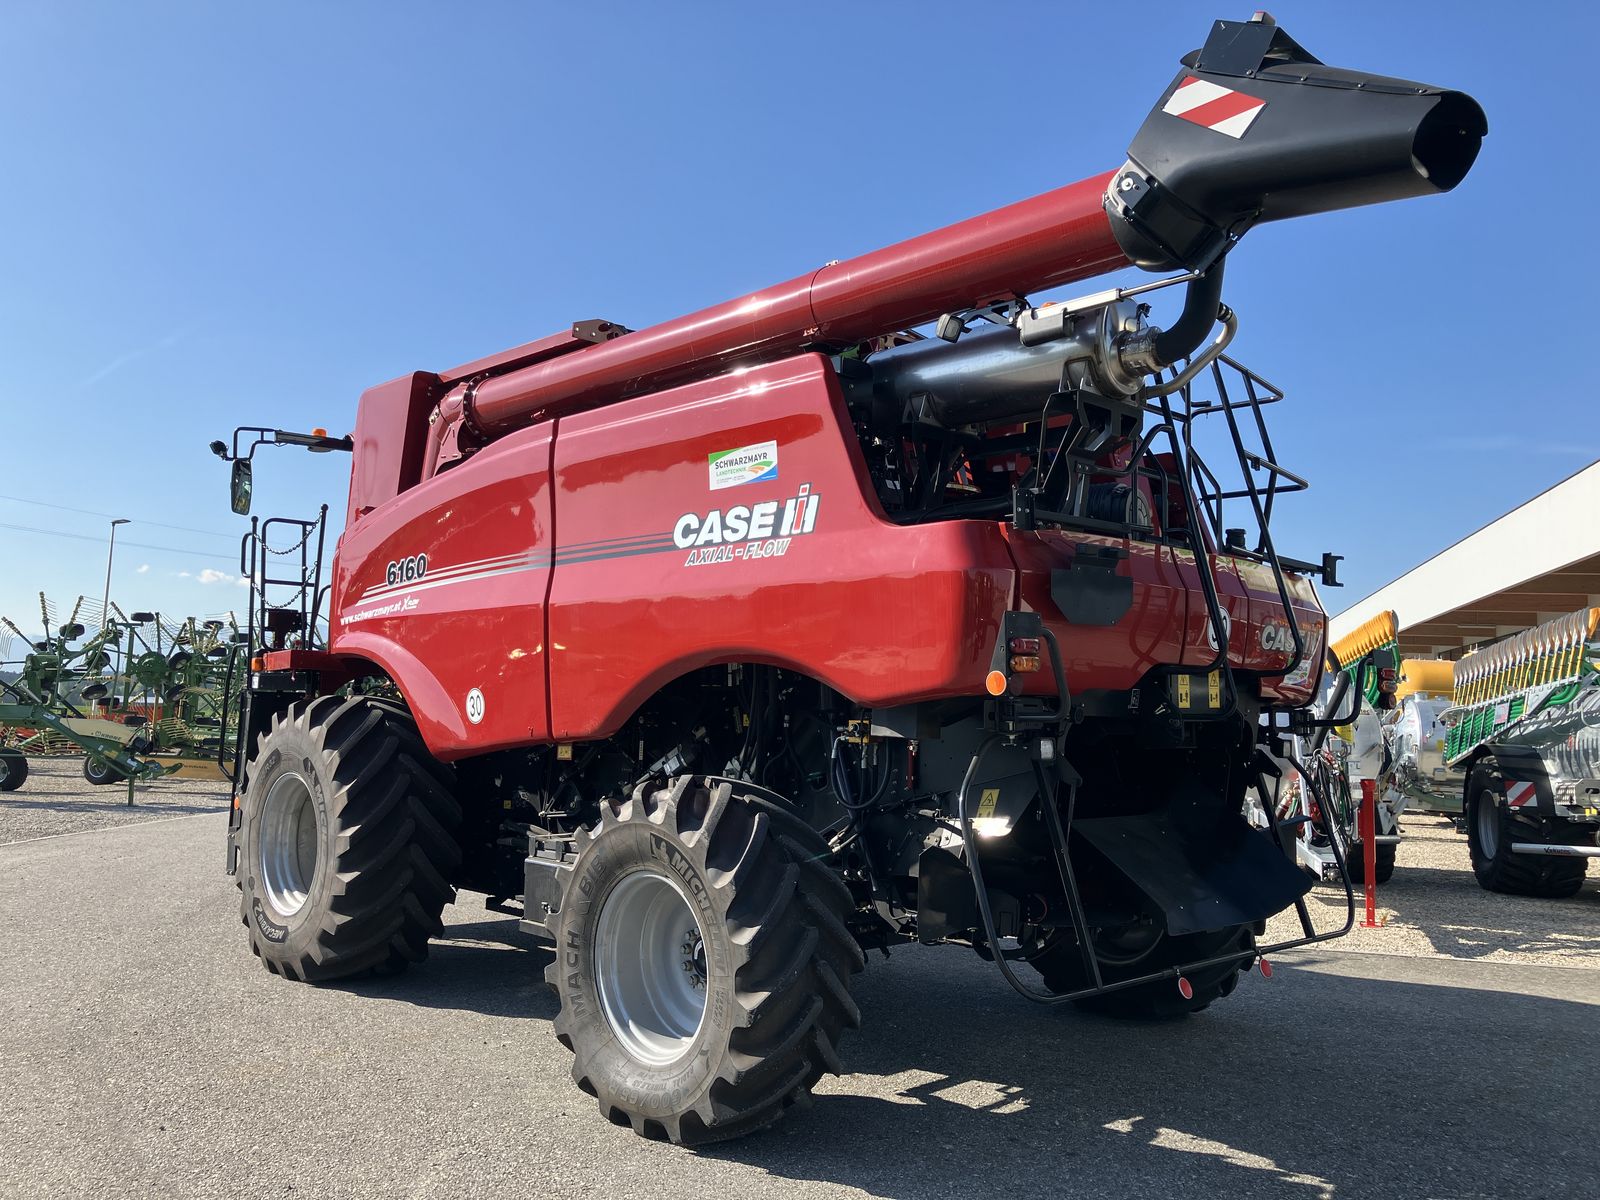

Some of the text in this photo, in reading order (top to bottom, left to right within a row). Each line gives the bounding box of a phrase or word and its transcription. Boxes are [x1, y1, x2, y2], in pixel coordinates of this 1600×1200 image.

[715, 452, 768, 470] SCHWARZMAYR
[673, 501, 779, 549] CASE
[385, 553, 428, 586] 6160
[469, 695, 482, 717] 30
[254, 903, 263, 917] 2
